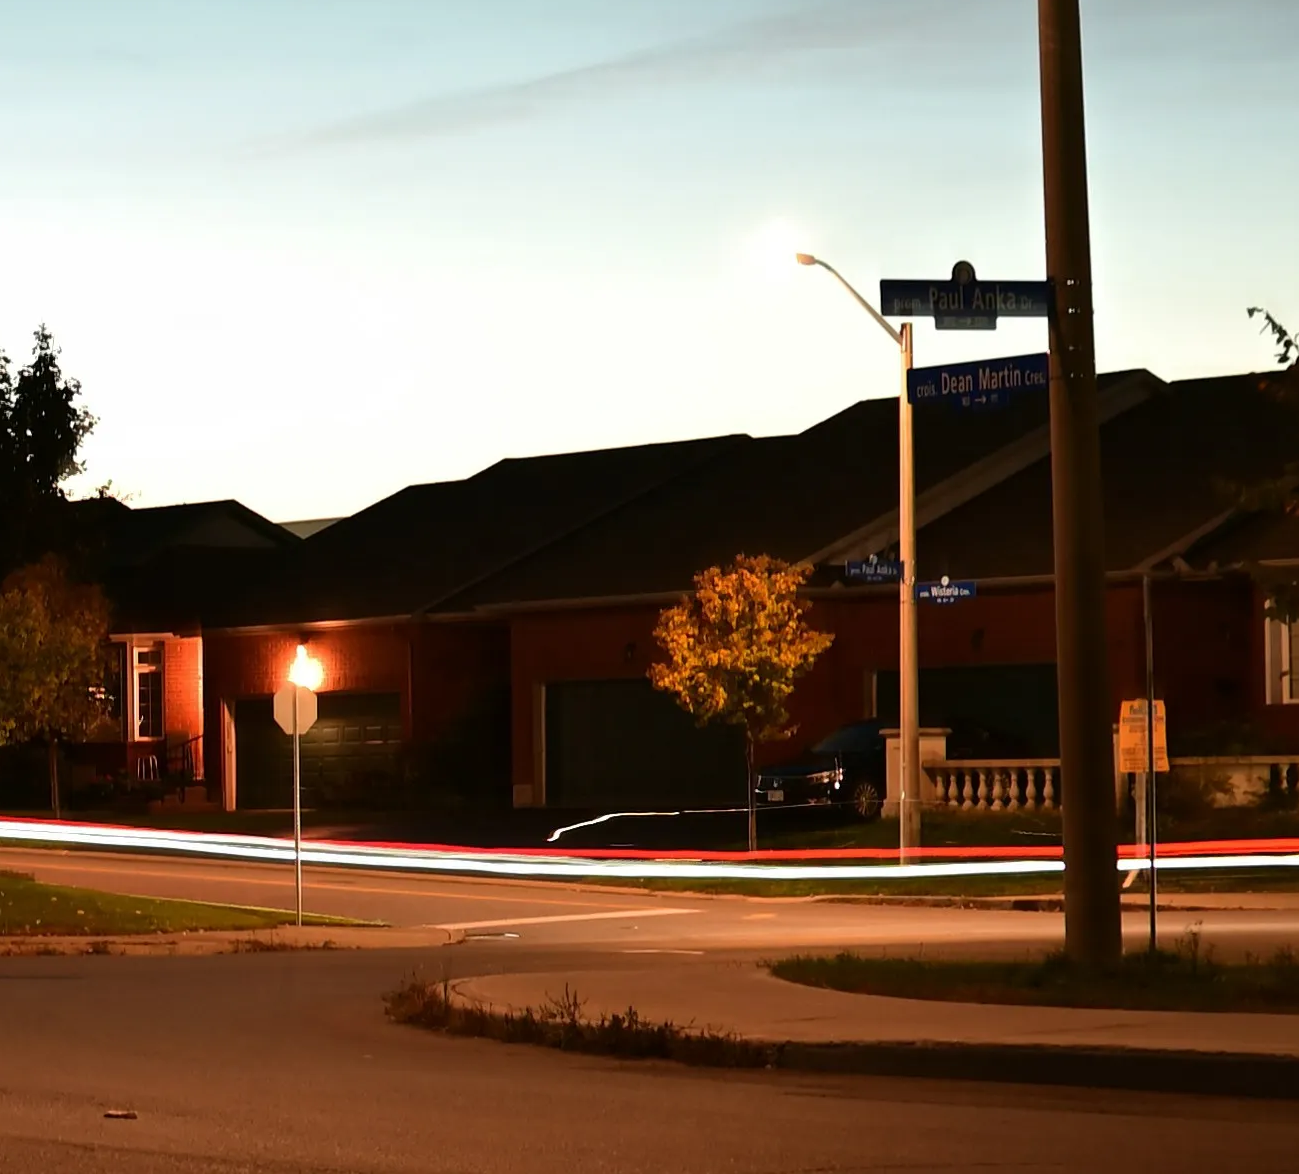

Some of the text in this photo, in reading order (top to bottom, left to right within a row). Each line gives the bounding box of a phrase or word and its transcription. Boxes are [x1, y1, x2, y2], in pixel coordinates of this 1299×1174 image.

[929, 285, 964, 311] Paul
[972, 284, 1016, 311] Anka
[916, 363, 1046, 398] crois. Dean Martin Cres.
[931, 584, 959, 597] Wisteria
